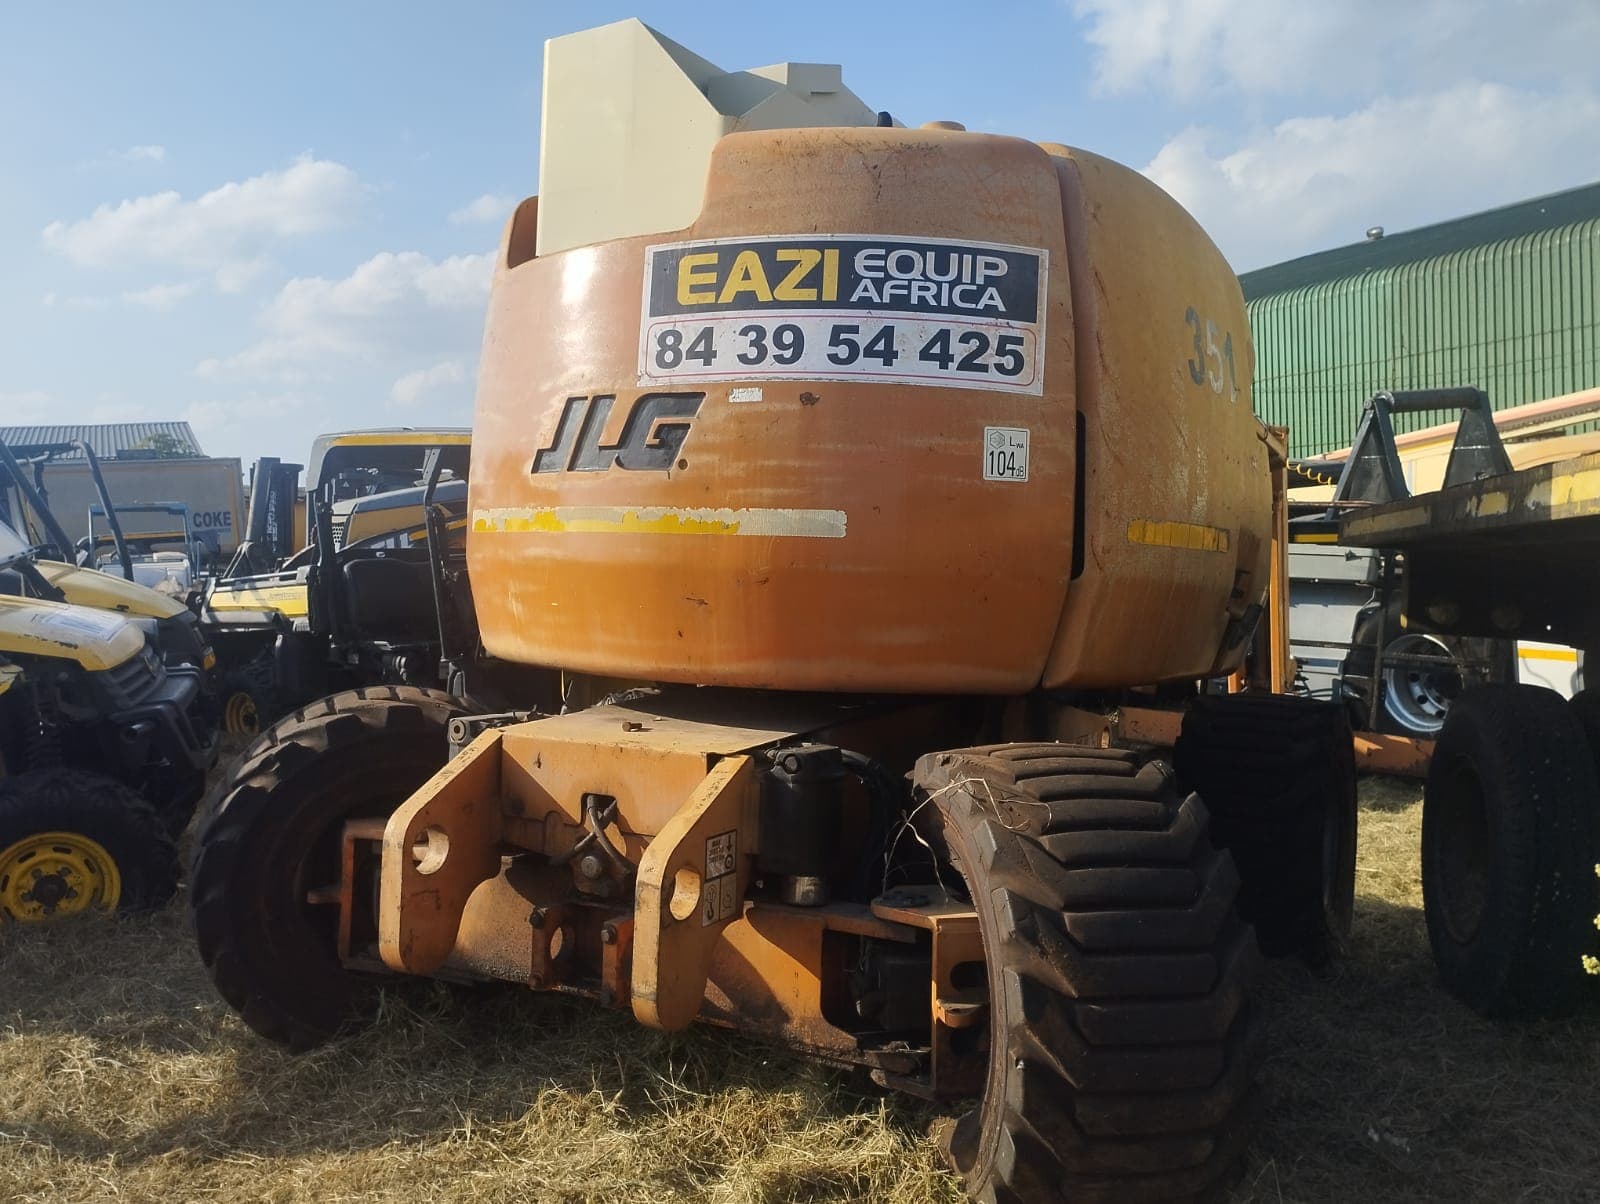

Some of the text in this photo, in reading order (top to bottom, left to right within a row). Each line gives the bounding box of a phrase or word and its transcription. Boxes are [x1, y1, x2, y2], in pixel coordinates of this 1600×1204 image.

[677, 248, 840, 306] EAZI
[853, 248, 1009, 286] EQUIP
[849, 278, 1007, 312] AFRICA
[655, 324, 1025, 376] 84 39 54 425
[531, 392, 706, 474] JLG
[193, 511, 231, 528] COKE
